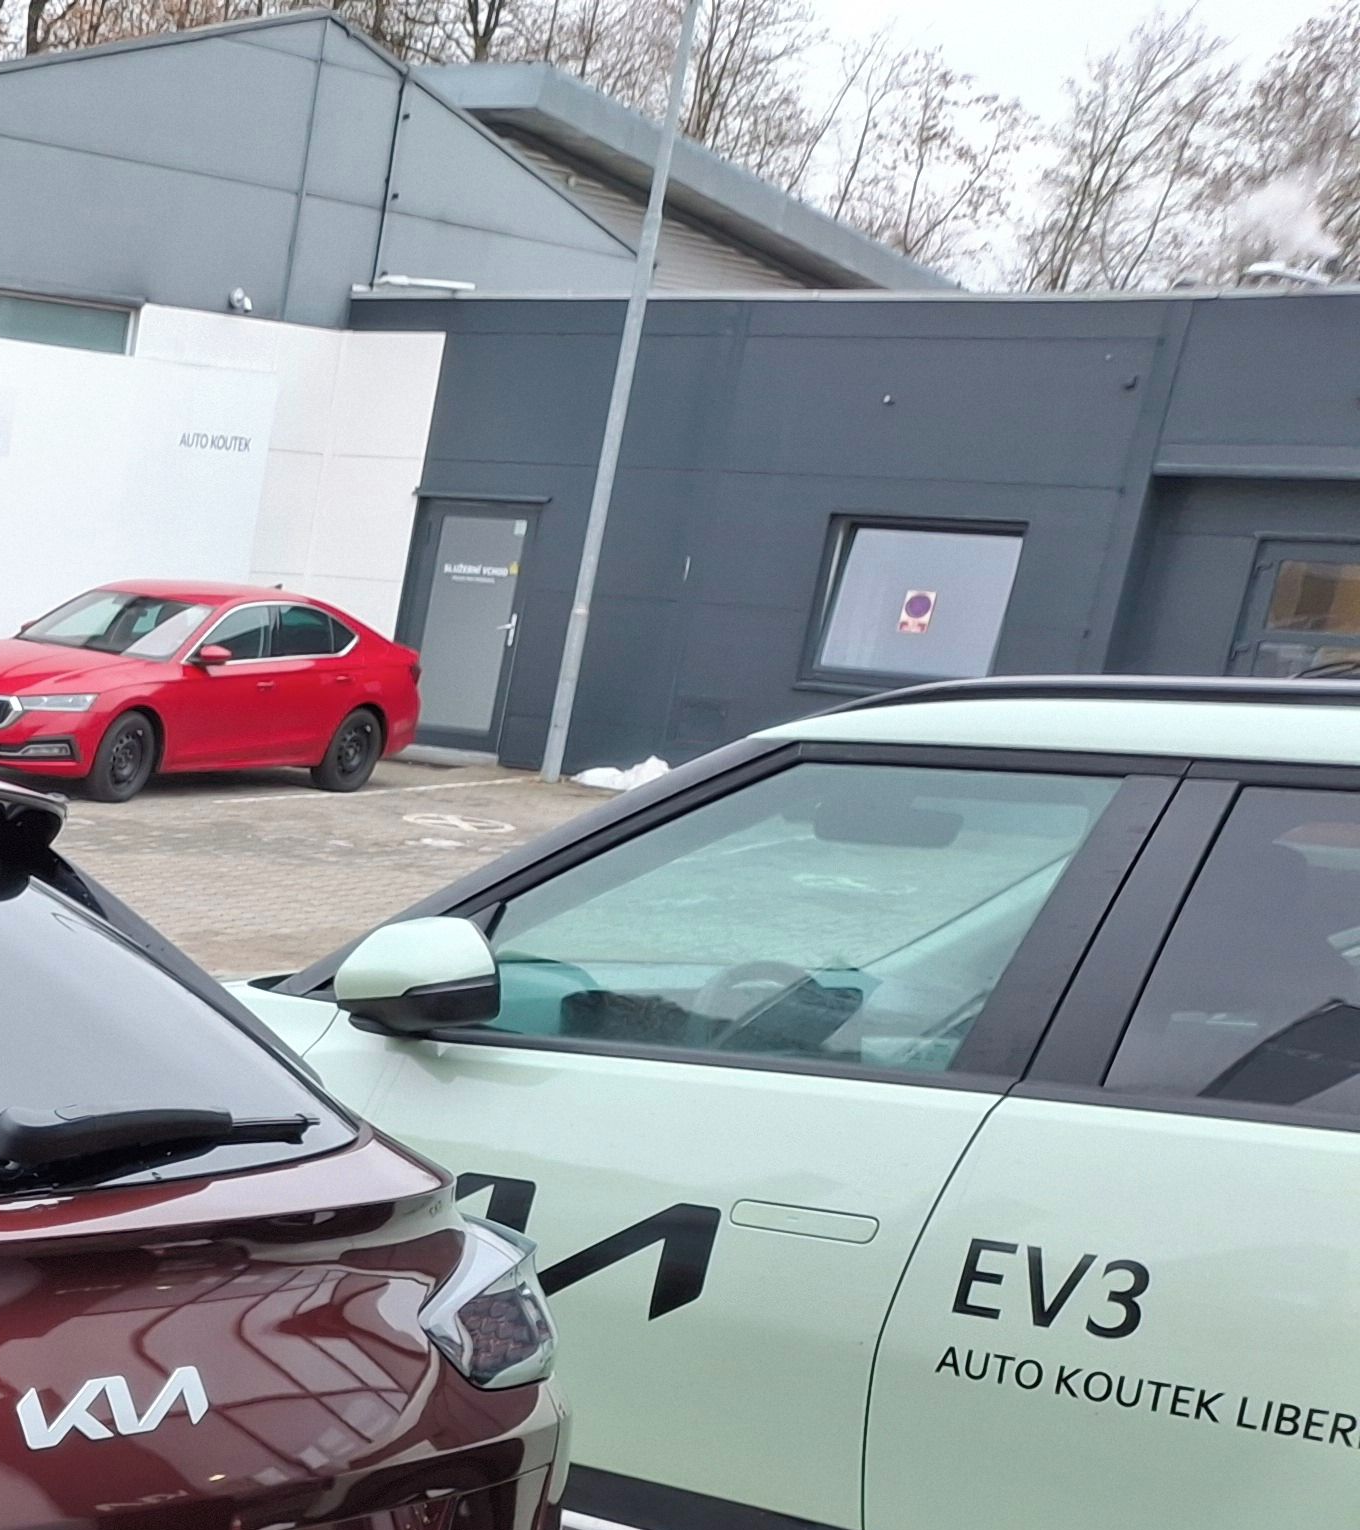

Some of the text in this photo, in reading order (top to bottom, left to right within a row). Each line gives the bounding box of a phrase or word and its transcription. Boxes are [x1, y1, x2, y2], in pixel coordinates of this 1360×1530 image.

[179, 432, 252, 453] AUTO KOUTEK
[951, 1237, 1151, 1339] EV3
[15, 1365, 210, 1451] KIA
[935, 1346, 1360, 1450] AUTO KOUTEK LIBER
